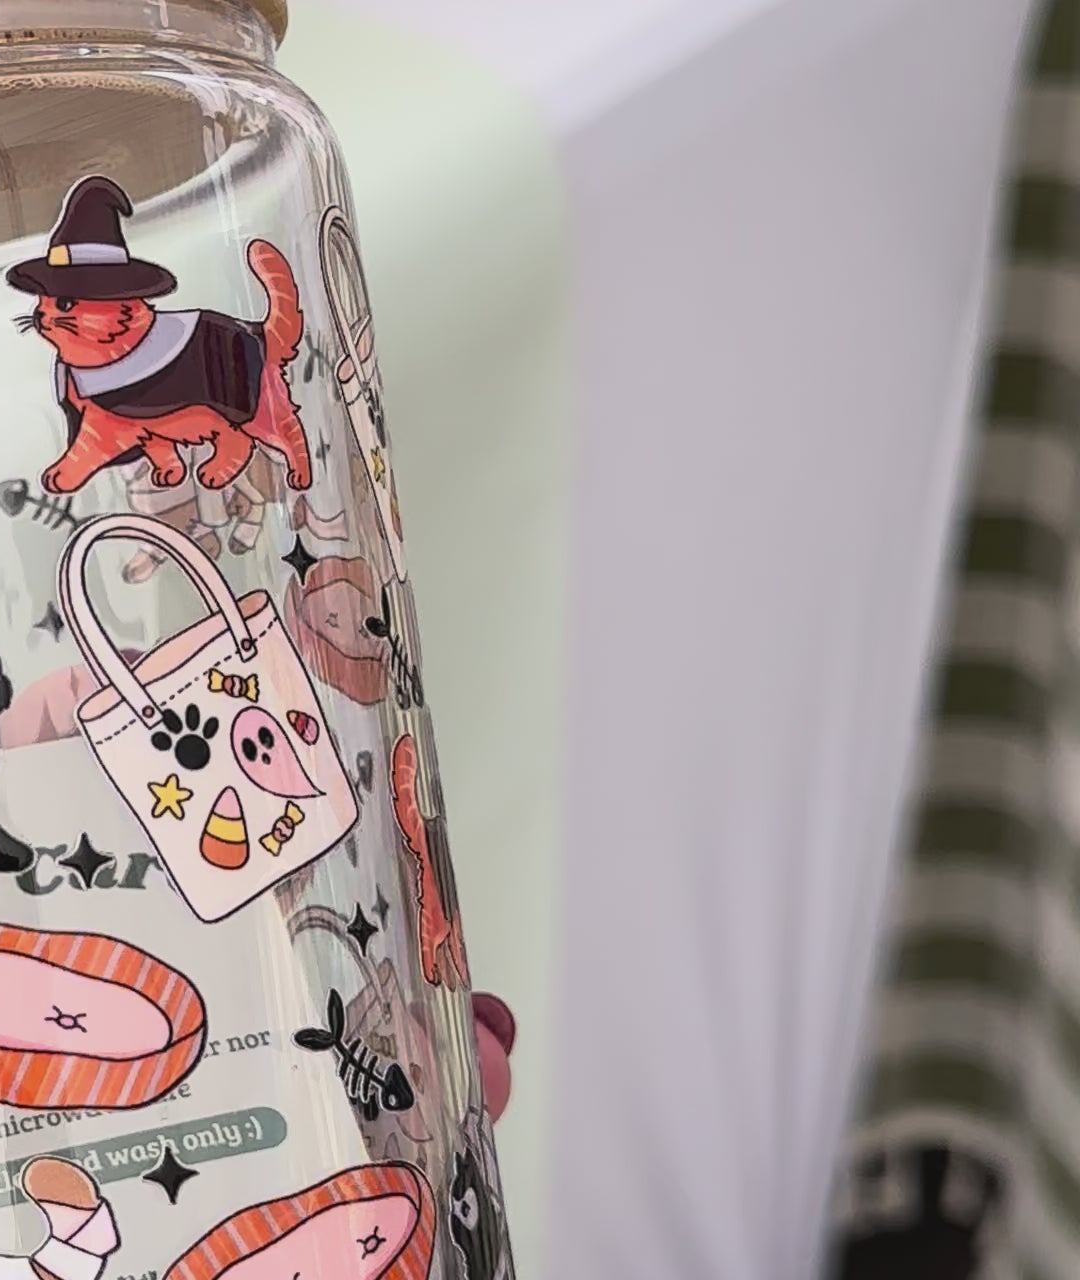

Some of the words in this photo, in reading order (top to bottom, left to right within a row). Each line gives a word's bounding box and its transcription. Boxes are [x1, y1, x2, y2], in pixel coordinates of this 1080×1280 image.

[226, 1030, 271, 1052] nor
[104, 1135, 180, 1166] wash
[183, 1123, 243, 1152] only
